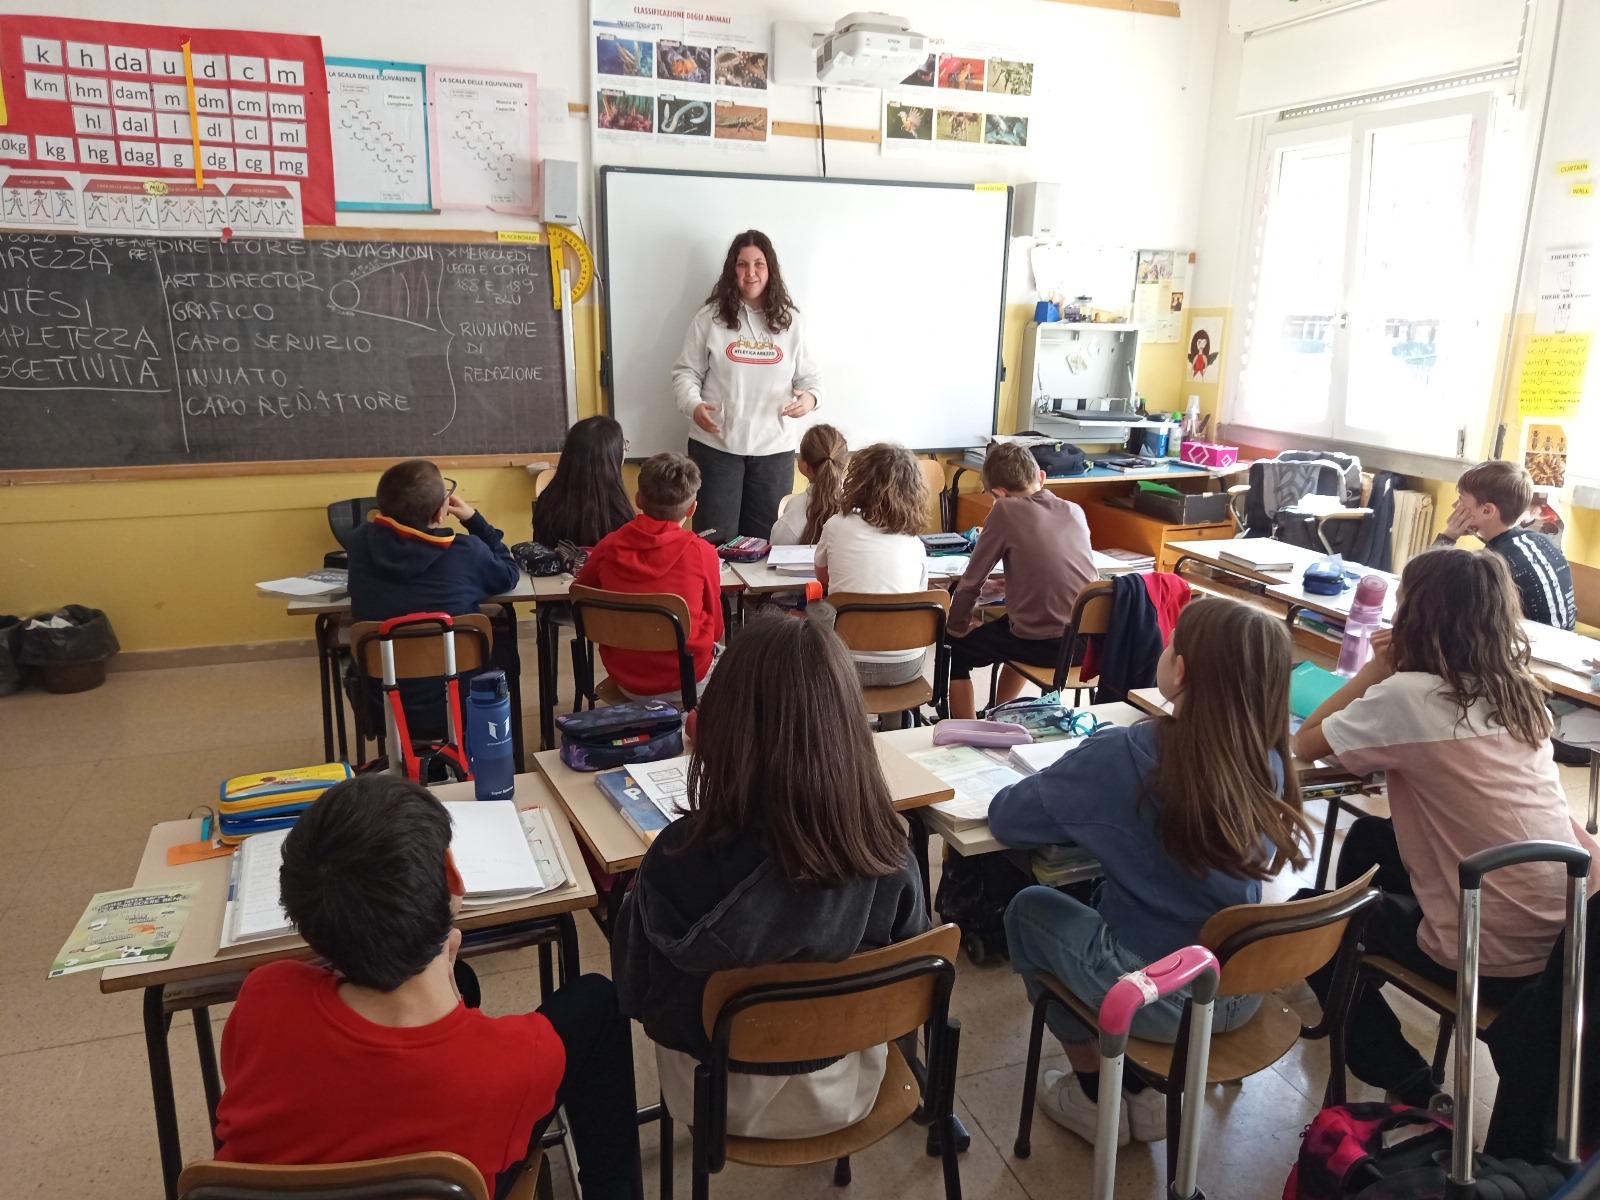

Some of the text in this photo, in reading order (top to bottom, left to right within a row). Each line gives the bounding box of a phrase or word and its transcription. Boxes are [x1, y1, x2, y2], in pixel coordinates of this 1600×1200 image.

[633, 6, 732, 24] CLASSIFICAZIONE DEGLI ANIMALI
[37, 44, 297, 83] k h da u d c m
[338, 72, 357, 80] SCALA
[358, 73, 375, 81] DELLE
[377, 75, 417, 83] EQUIVALENZE
[448, 78, 467, 86] SCALA
[468, 79, 484, 87] DELLE
[486, 80, 524, 89] EQUIVALENZE
[76, 83, 103, 98] hm
[116, 86, 148, 101] dam
[165, 94, 181, 106] m
[198, 94, 224, 109] dm
[237, 99, 262, 112] cm
[272, 102, 303, 115] mm
[86, 113, 102, 129] hl
[122, 117, 148, 133] dal
[207, 123, 221, 138] dl
[245, 126, 259, 140] cl
[280, 129, 300, 143] ml
[0, 138, 304, 176] 0kg kg hg dag g dg cg mg
[1560, 164, 1588, 173] CURTAIN
[500, 233, 537, 242] BLACKBOARD
[158, 239, 433, 261] DIRETTORE SALVAGNONI
[164, 270, 325, 292] ART DIRECTOR
[172, 301, 275, 321] GRAFICO
[459, 320, 537, 338] RIUNIONE
[177, 331, 372, 353] CAPO SERVIZIO
[465, 342, 483, 354] DI
[186, 366, 288, 388] INVIATO
[464, 366, 543, 382] REDAZIONE
[186, 394, 246, 418] CAPO
